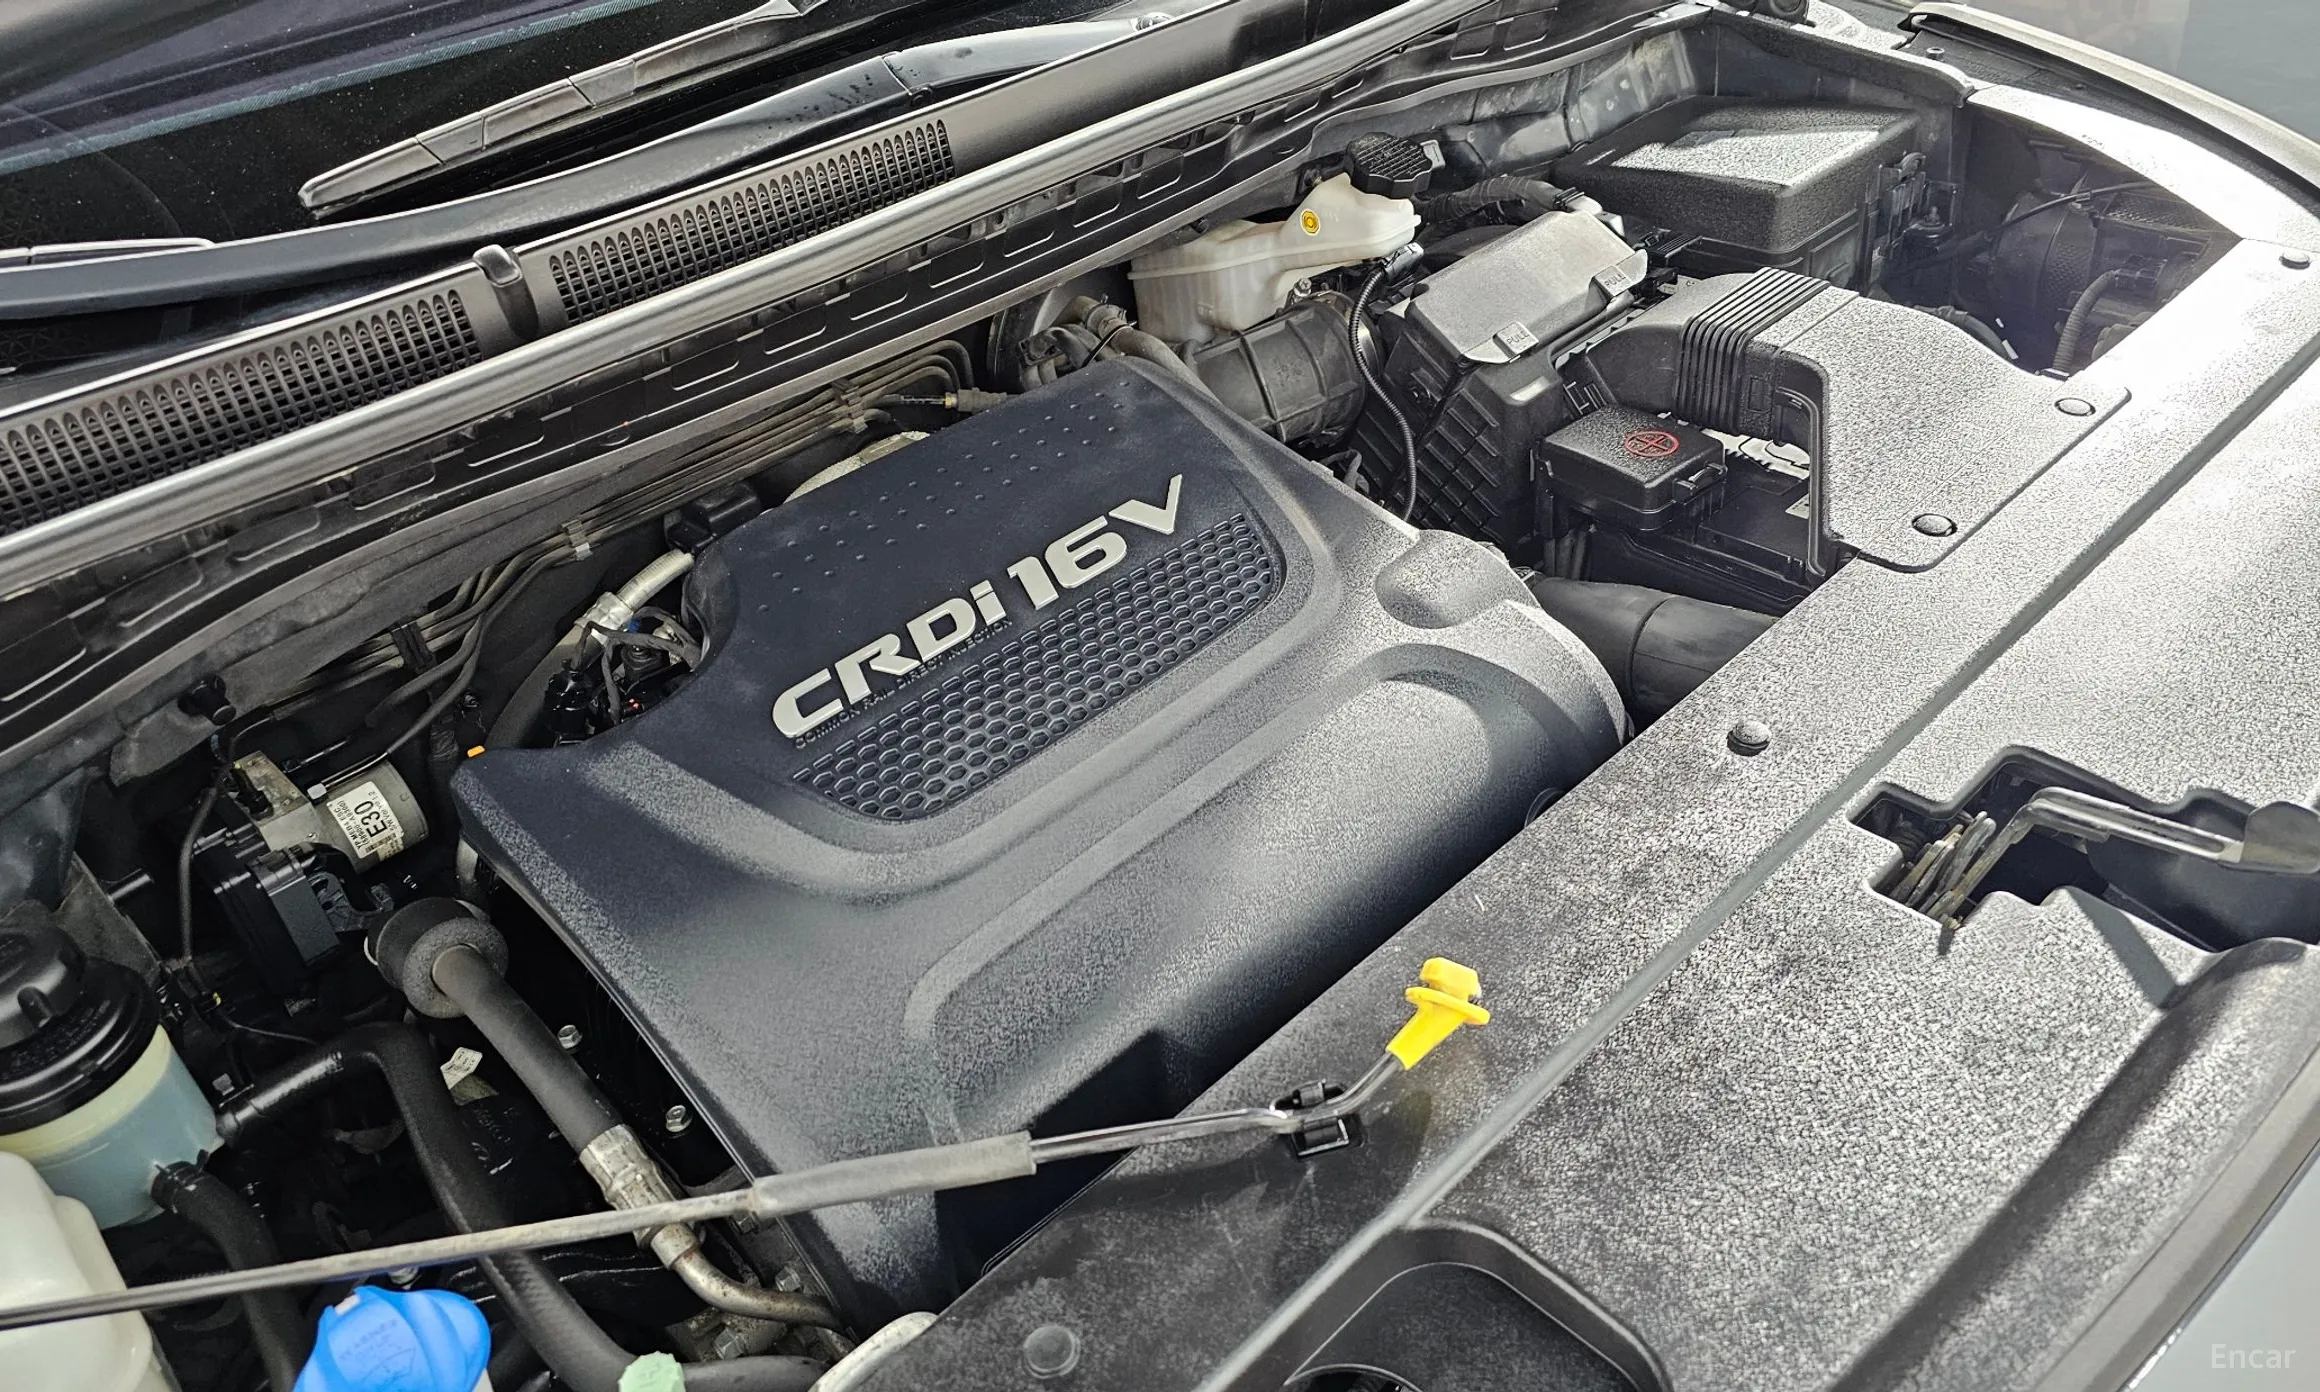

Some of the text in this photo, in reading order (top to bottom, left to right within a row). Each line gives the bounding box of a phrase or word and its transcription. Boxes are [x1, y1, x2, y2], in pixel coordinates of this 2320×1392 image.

[1507, 331, 1530, 344] PULL
[771, 473, 1184, 740] CRDi 16V
[793, 619, 1013, 749] COMMON RAIL DIRECT INJECTION
[354, 801, 388, 837] E30
